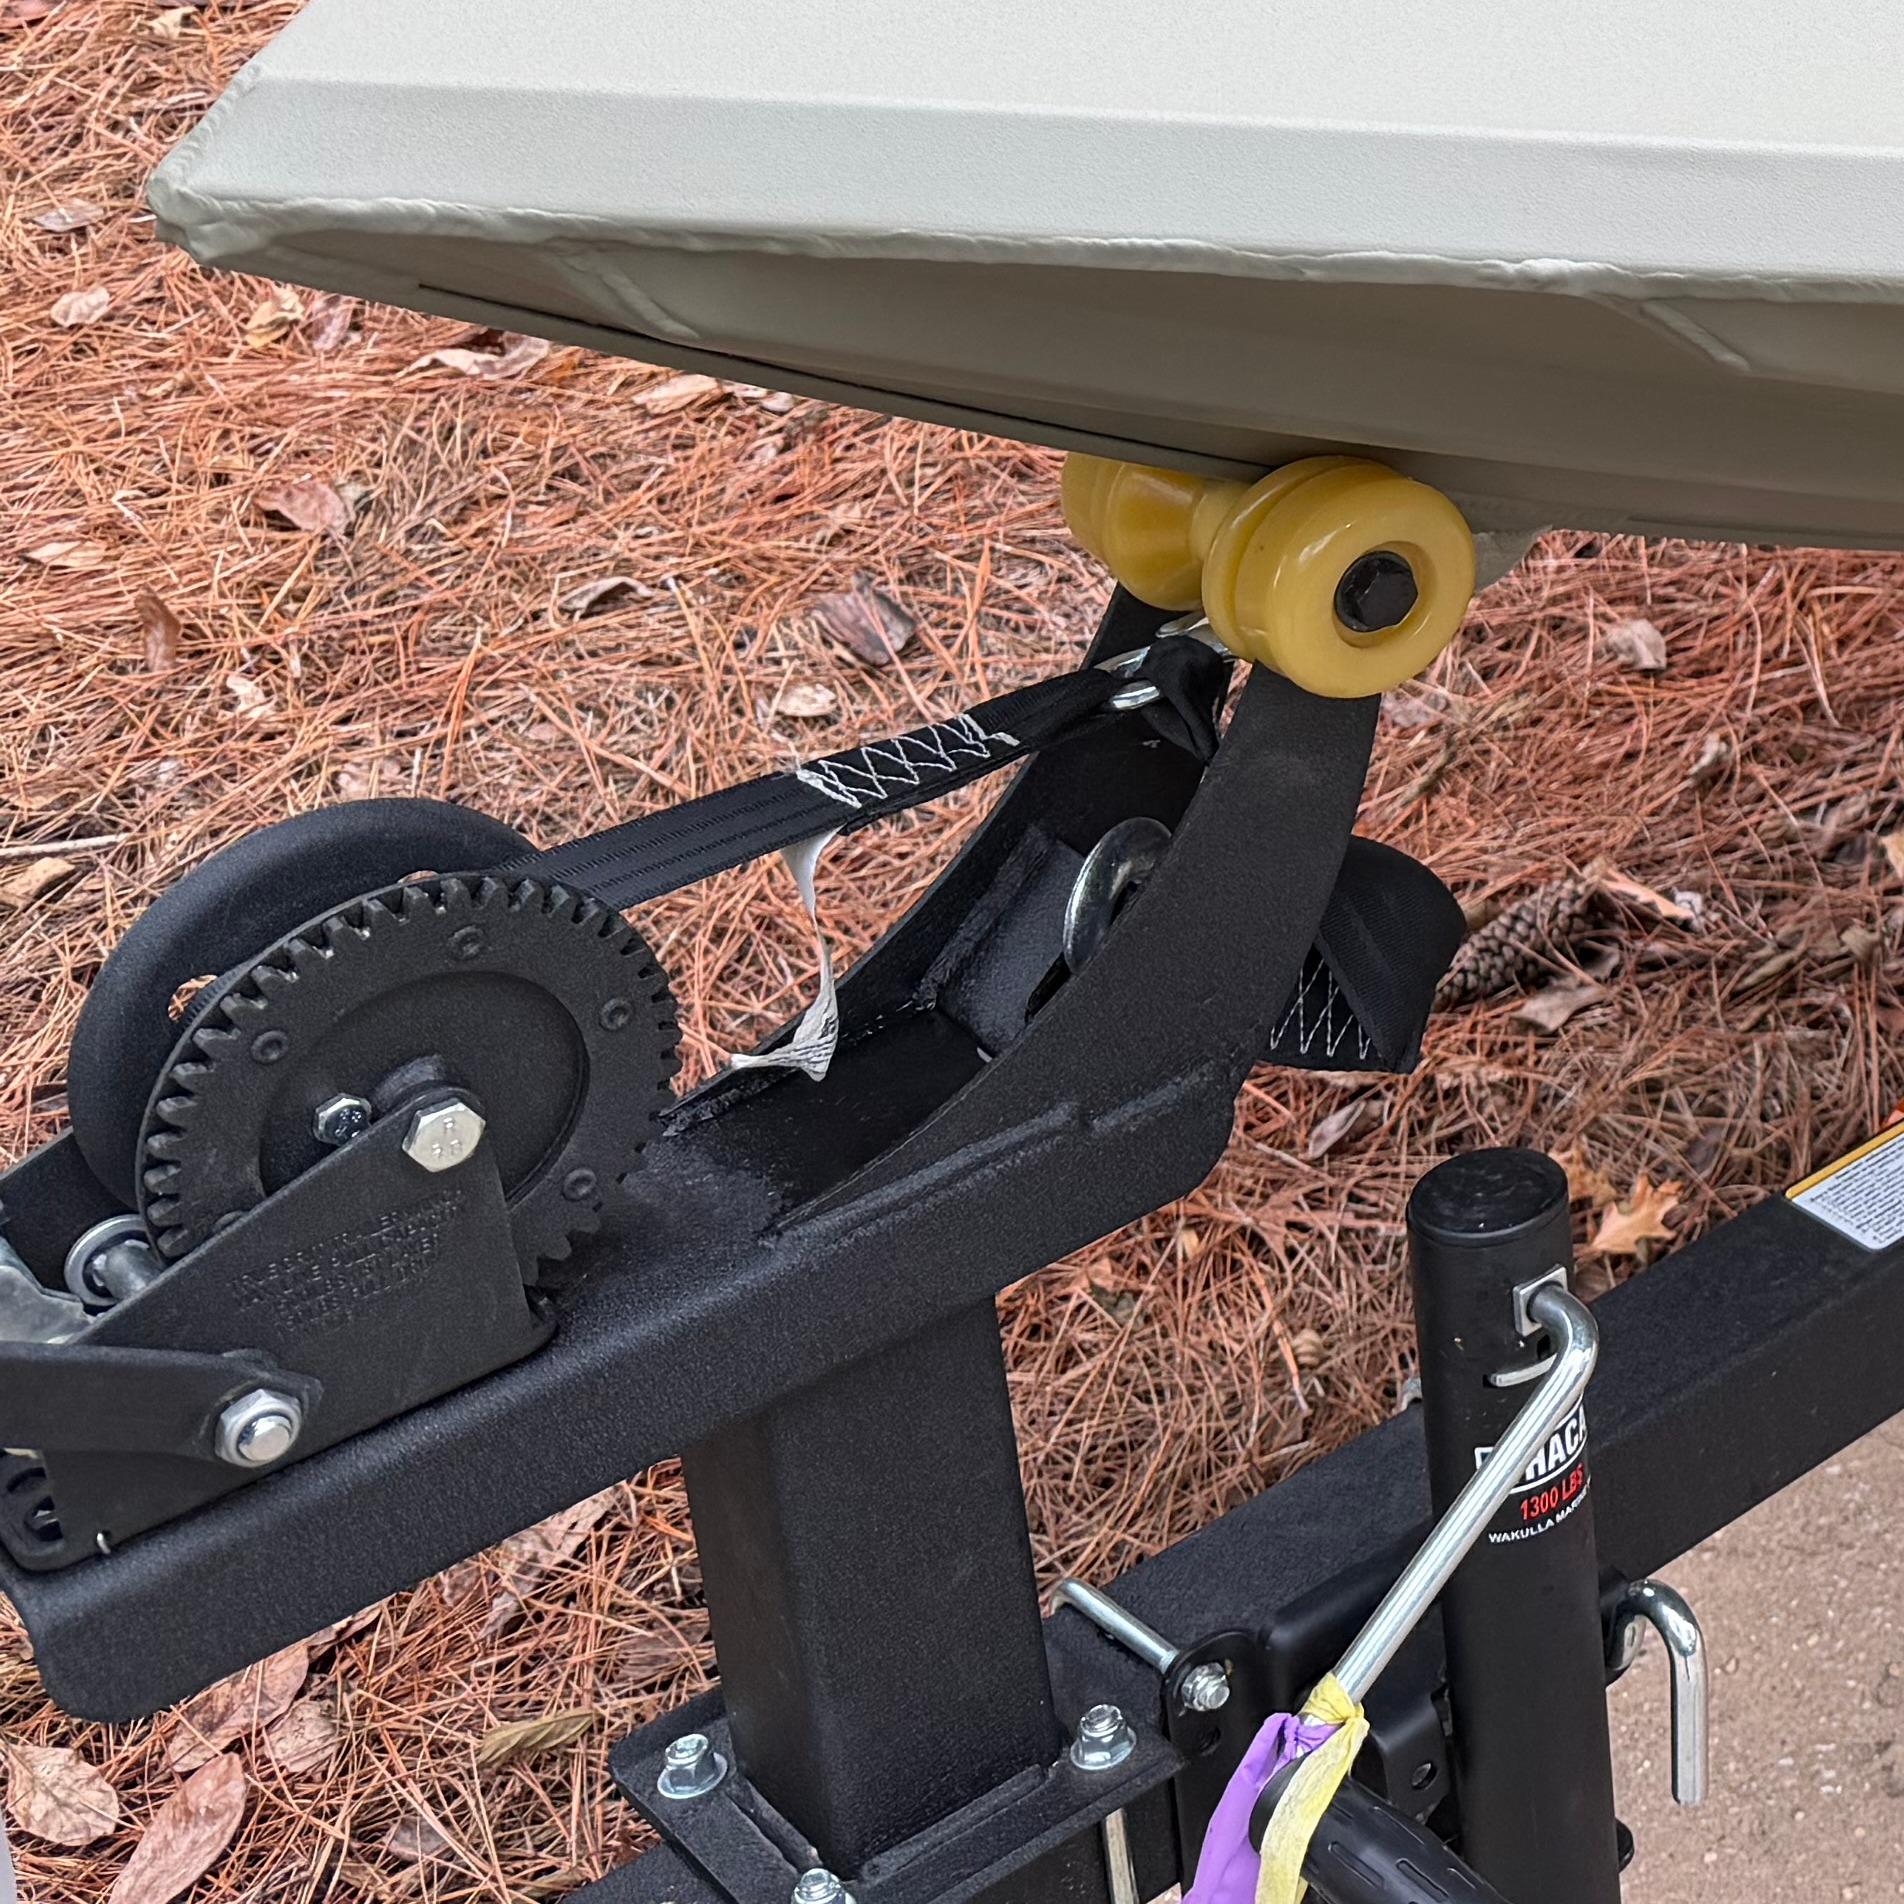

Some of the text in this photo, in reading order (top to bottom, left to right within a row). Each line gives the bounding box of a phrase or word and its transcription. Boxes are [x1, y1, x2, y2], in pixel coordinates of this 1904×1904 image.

[1520, 1462, 1584, 1520] 1300 LBS
[1488, 1518, 1555, 1543] WAKULLA
